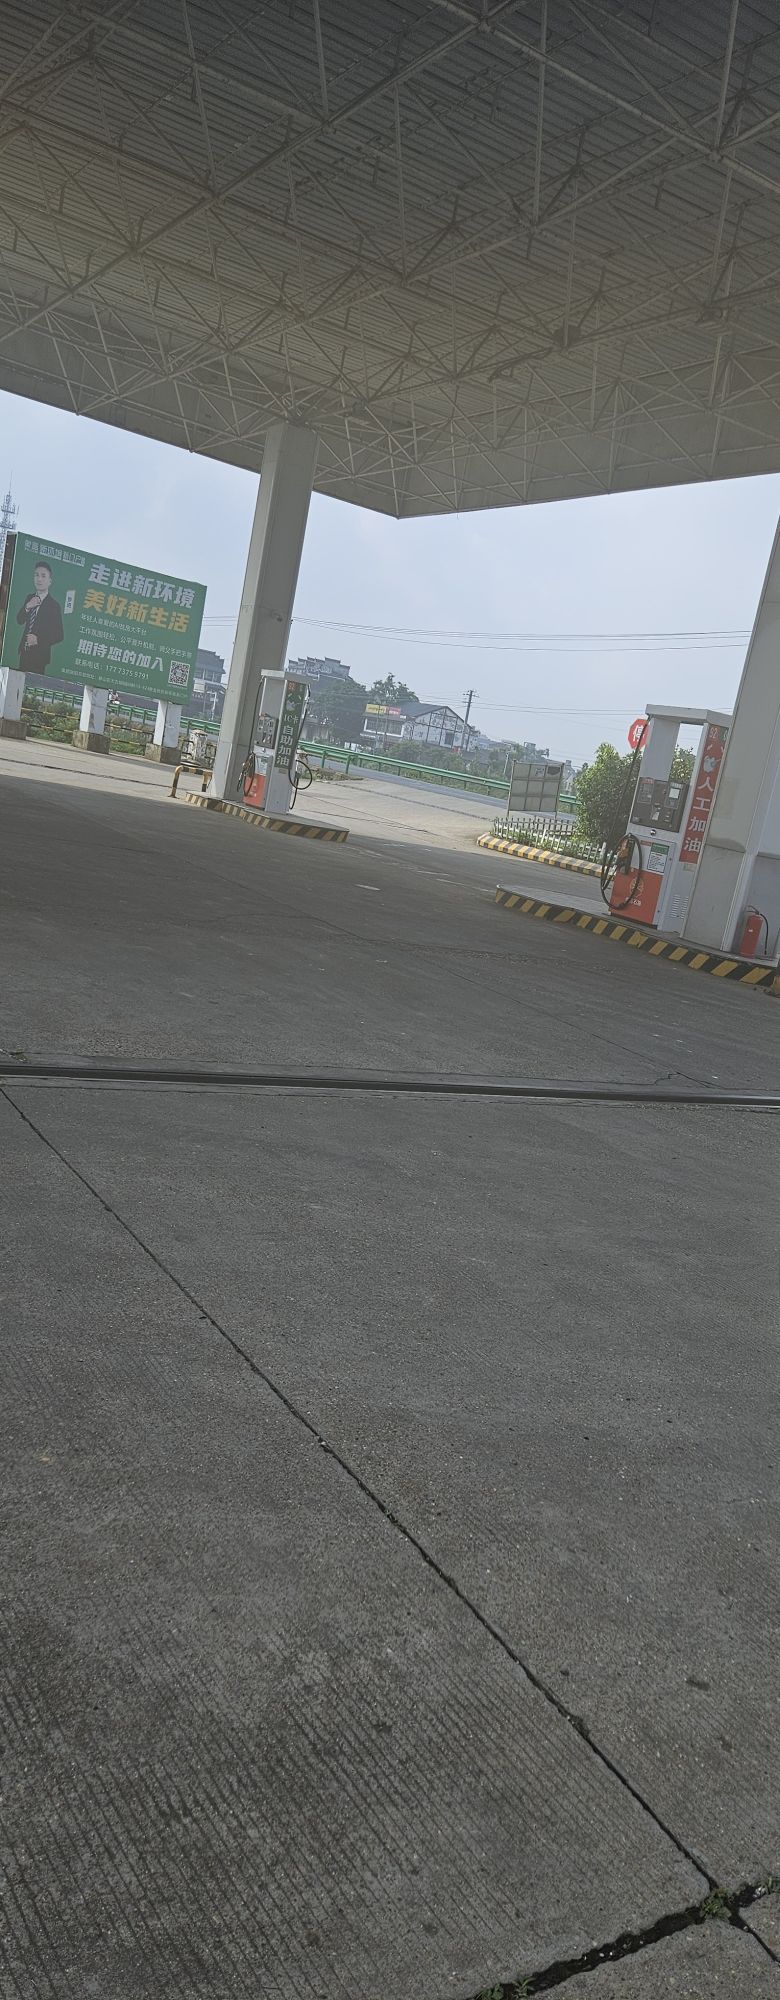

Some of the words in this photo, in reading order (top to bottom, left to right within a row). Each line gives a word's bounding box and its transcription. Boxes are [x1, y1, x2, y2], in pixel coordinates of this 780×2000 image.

[88, 563, 196, 609] 走进新环境
[83, 588, 190, 633] 美好新生活
[77, 639, 164, 672] 期待您的加入
[276, 725, 294, 767] 自助加油
[633, 724, 645, 742] 停
[685, 776, 714, 852] 人工加油
